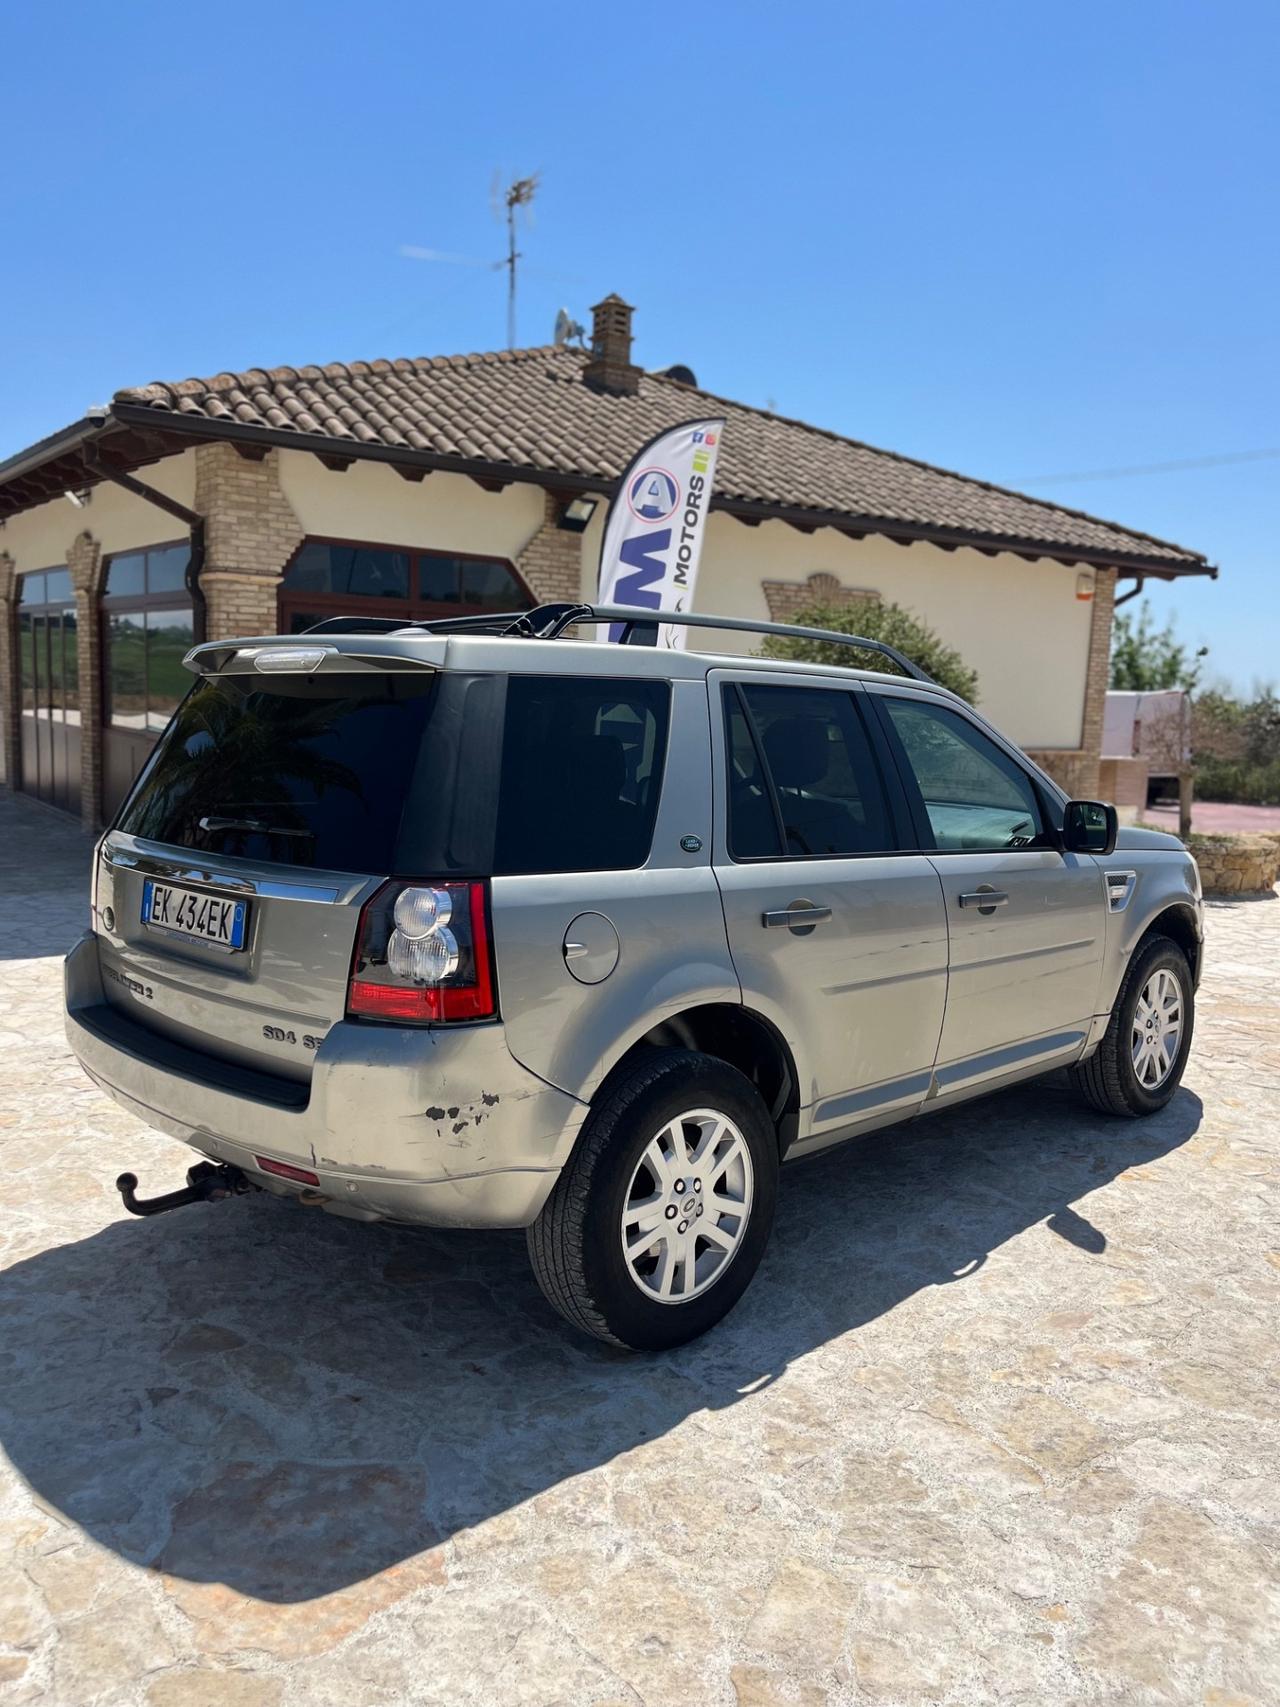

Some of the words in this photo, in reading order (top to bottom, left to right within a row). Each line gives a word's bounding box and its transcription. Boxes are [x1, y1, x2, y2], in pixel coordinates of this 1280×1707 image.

[673, 475, 705, 585] MOTORS
[152, 886, 172, 923] EK
[176, 894, 232, 940] 434EK
[262, 1025, 297, 1045] SD4
